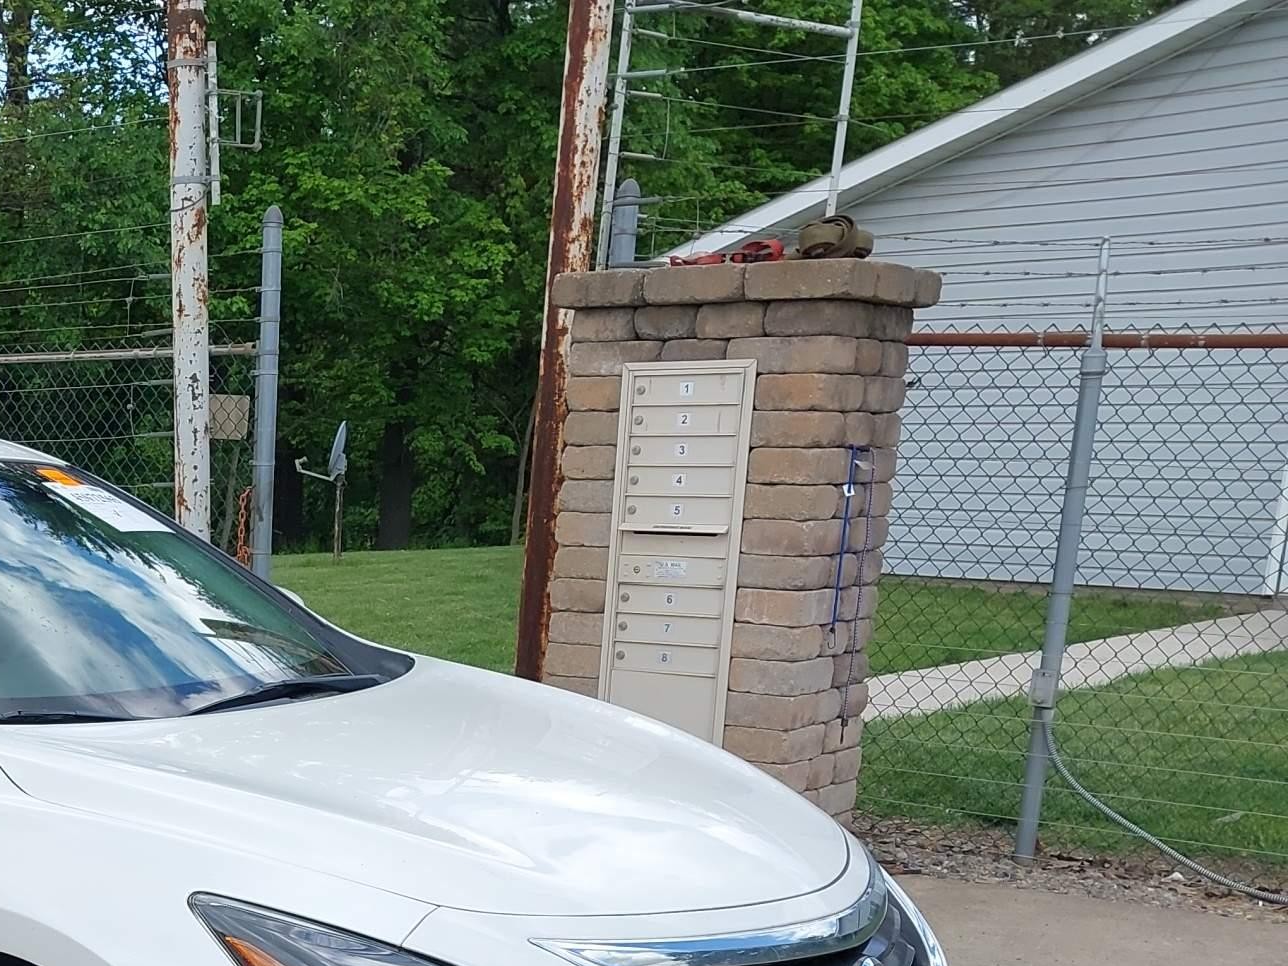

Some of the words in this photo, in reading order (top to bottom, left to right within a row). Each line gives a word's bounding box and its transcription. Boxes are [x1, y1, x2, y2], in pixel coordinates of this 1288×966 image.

[683, 384, 689, 394] 1
[682, 415, 688, 424] 2
[679, 446, 685, 455] 3
[676, 476, 683, 485] 4
[674, 505, 680, 515] 5
[667, 595, 672, 604] 6
[665, 624, 671, 632] 7
[661, 653, 667, 662] 8
